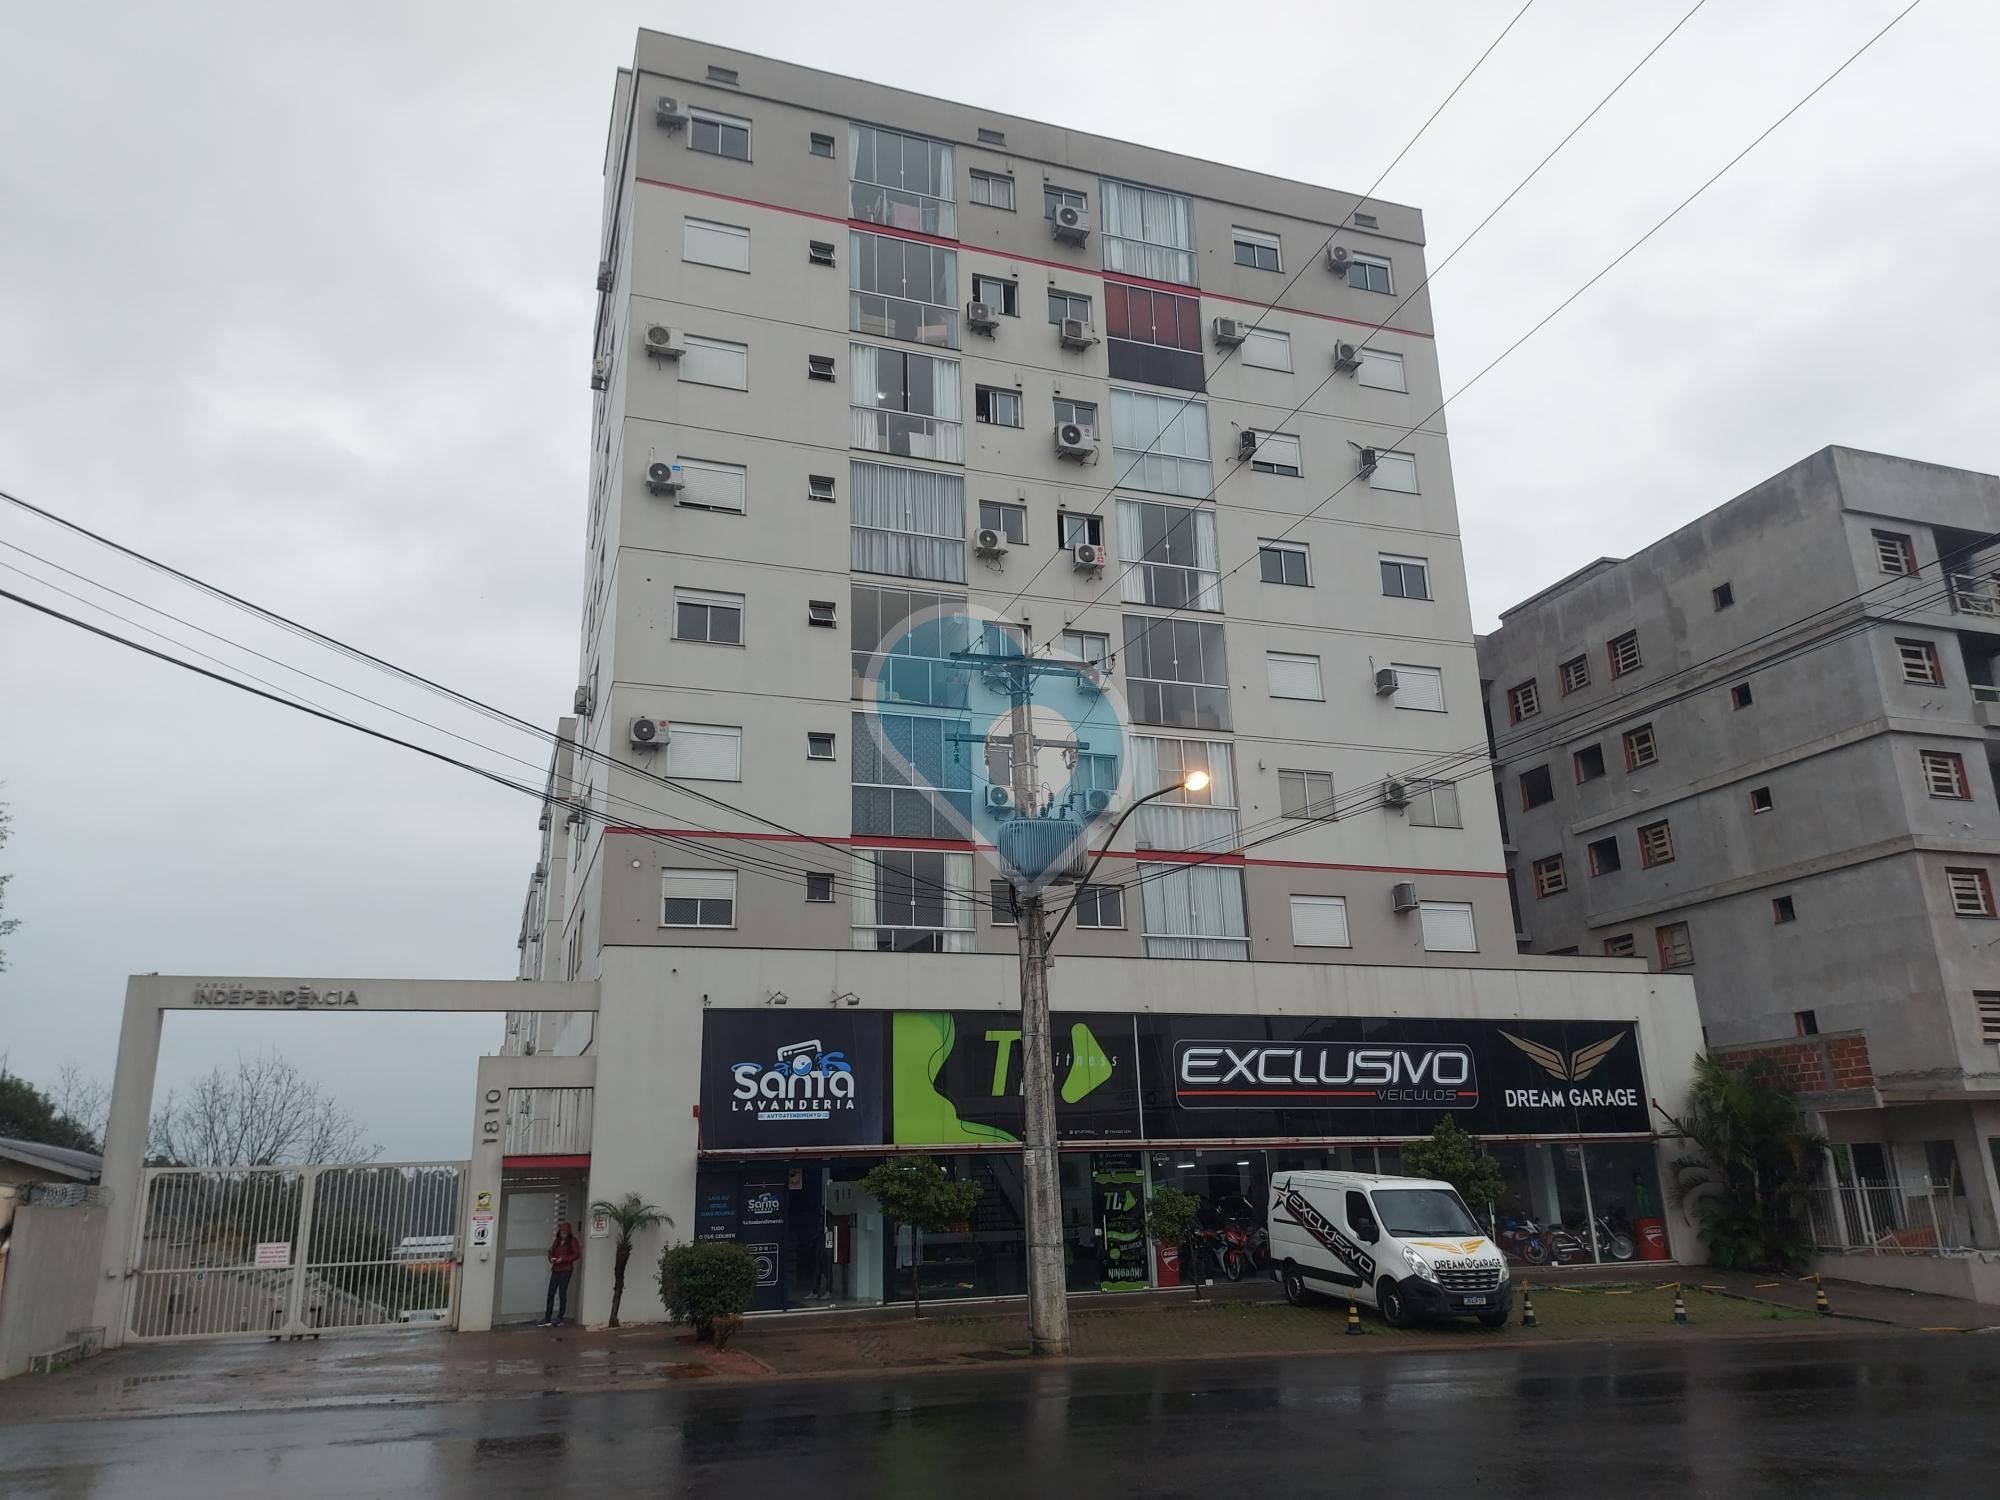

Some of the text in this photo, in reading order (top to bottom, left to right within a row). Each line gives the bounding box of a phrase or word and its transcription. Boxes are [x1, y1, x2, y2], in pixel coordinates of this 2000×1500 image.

[194, 985, 359, 1006] INDEPENDÊNCIA
[1055, 1052, 1118, 1067] itness
[1181, 1048, 1469, 1084] EXCLUSIVO
[1376, 1088, 1457, 1101] VEICULOS
[1505, 1089, 1638, 1108] DREAM GARAGE
[732, 1100, 855, 1111] LAVANDERIA
[482, 1089, 501, 1144] 1810
[1434, 1258, 1502, 1270] DREAM GARAGE
